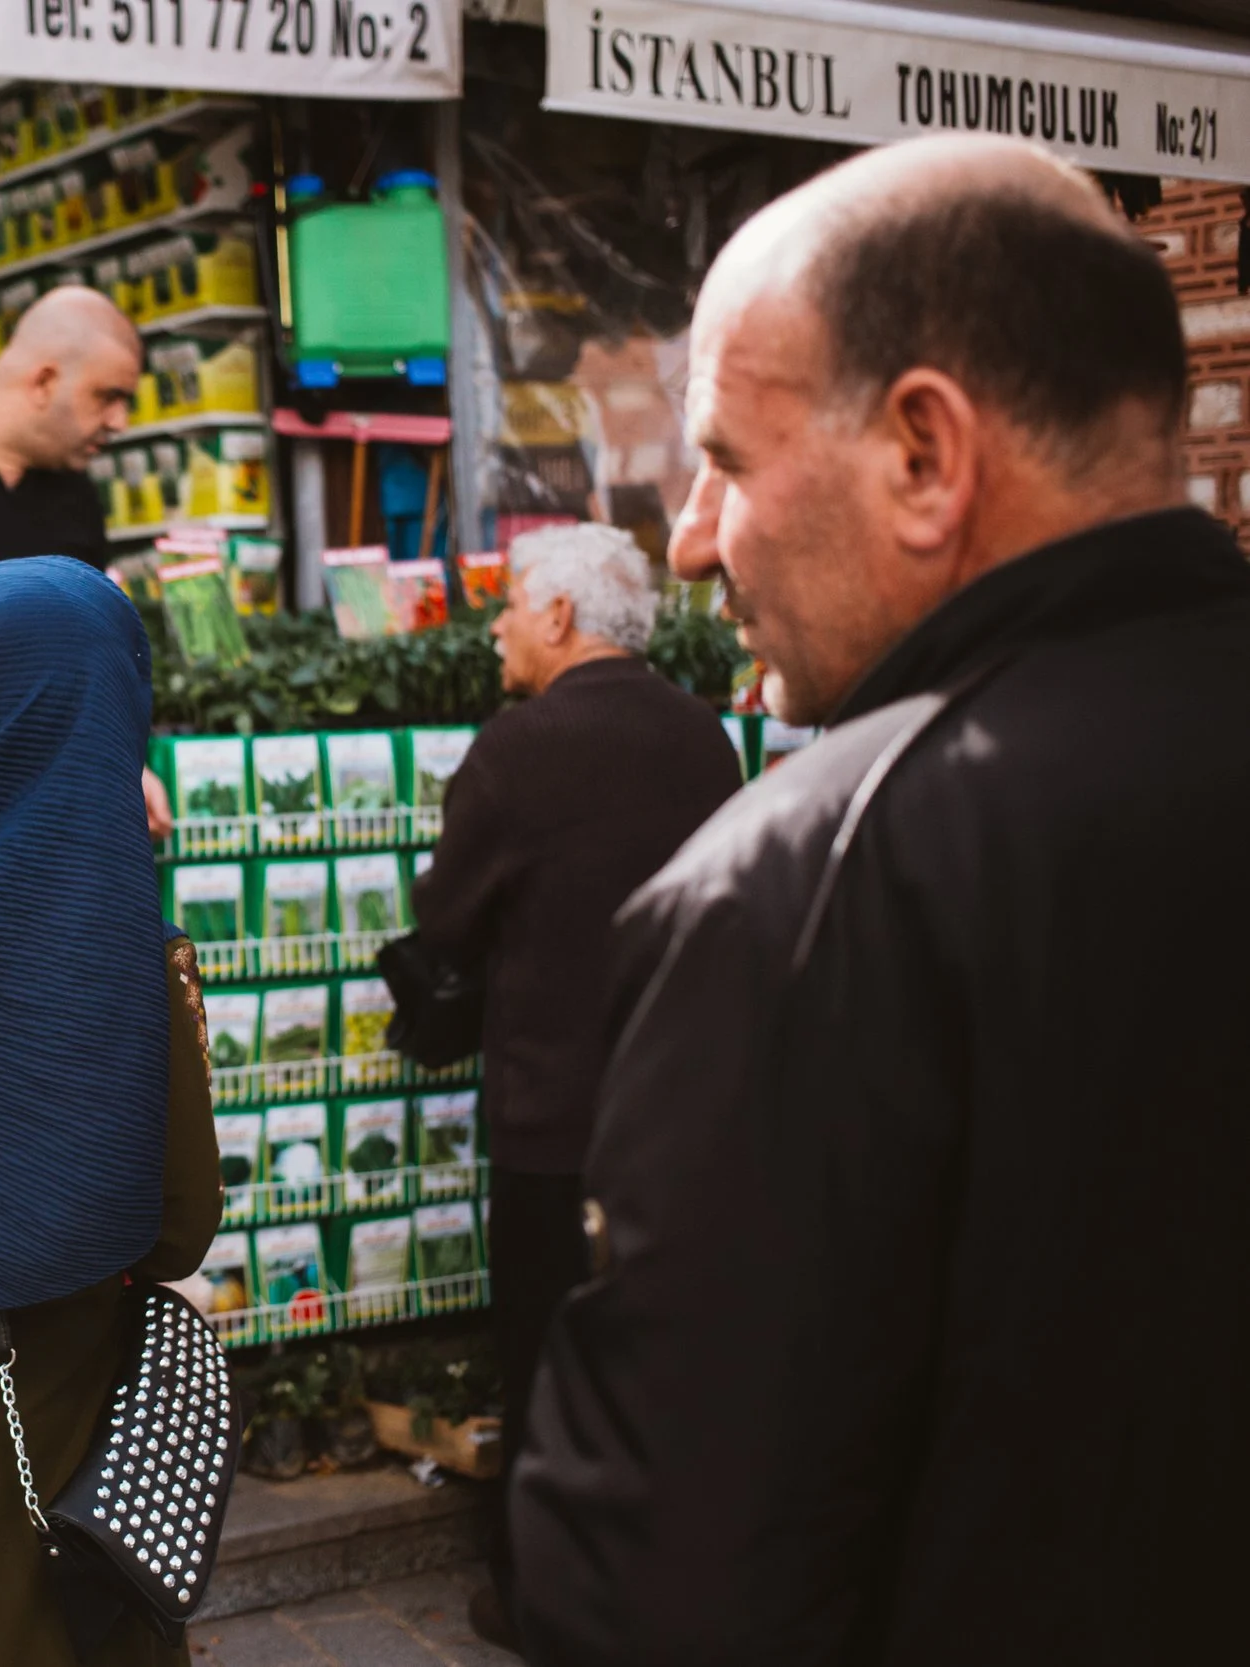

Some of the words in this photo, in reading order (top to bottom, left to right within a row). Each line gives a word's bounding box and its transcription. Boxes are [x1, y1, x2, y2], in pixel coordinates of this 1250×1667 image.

[111, 0, 182, 47] 511
[268, 0, 315, 55] 20
[331, 0, 391, 59] No:
[409, 2, 429, 60] 2
[589, 8, 851, 119] İSTANBUL
[897, 63, 1118, 149] TOHUMCULUK
[1155, 102, 1184, 156] No:
[1190, 106, 1217, 163] 2/1
